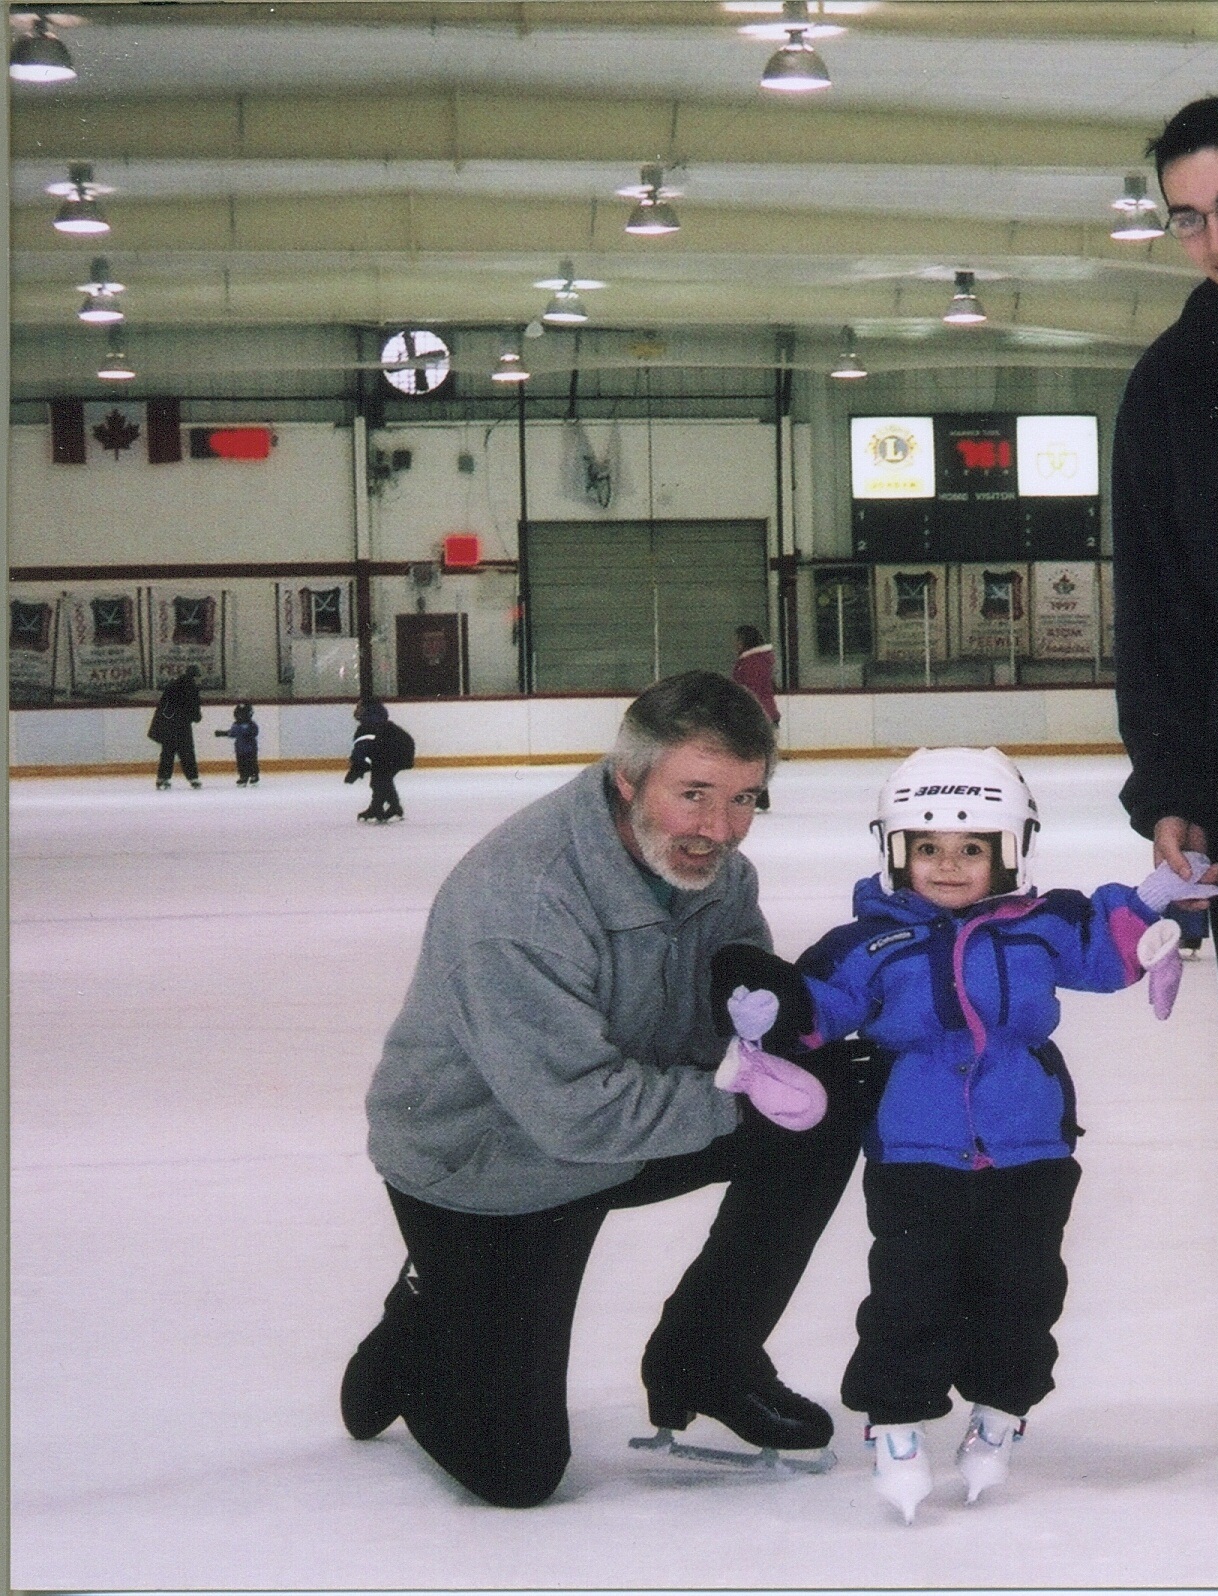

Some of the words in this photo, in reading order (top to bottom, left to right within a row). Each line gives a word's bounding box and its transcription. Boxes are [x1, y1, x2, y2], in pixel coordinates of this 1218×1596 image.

[938, 491, 969, 502] HOME
[974, 491, 1016, 501] VISITOR
[90, 667, 132, 681] ATOM
[914, 785, 982, 797] BAUER
